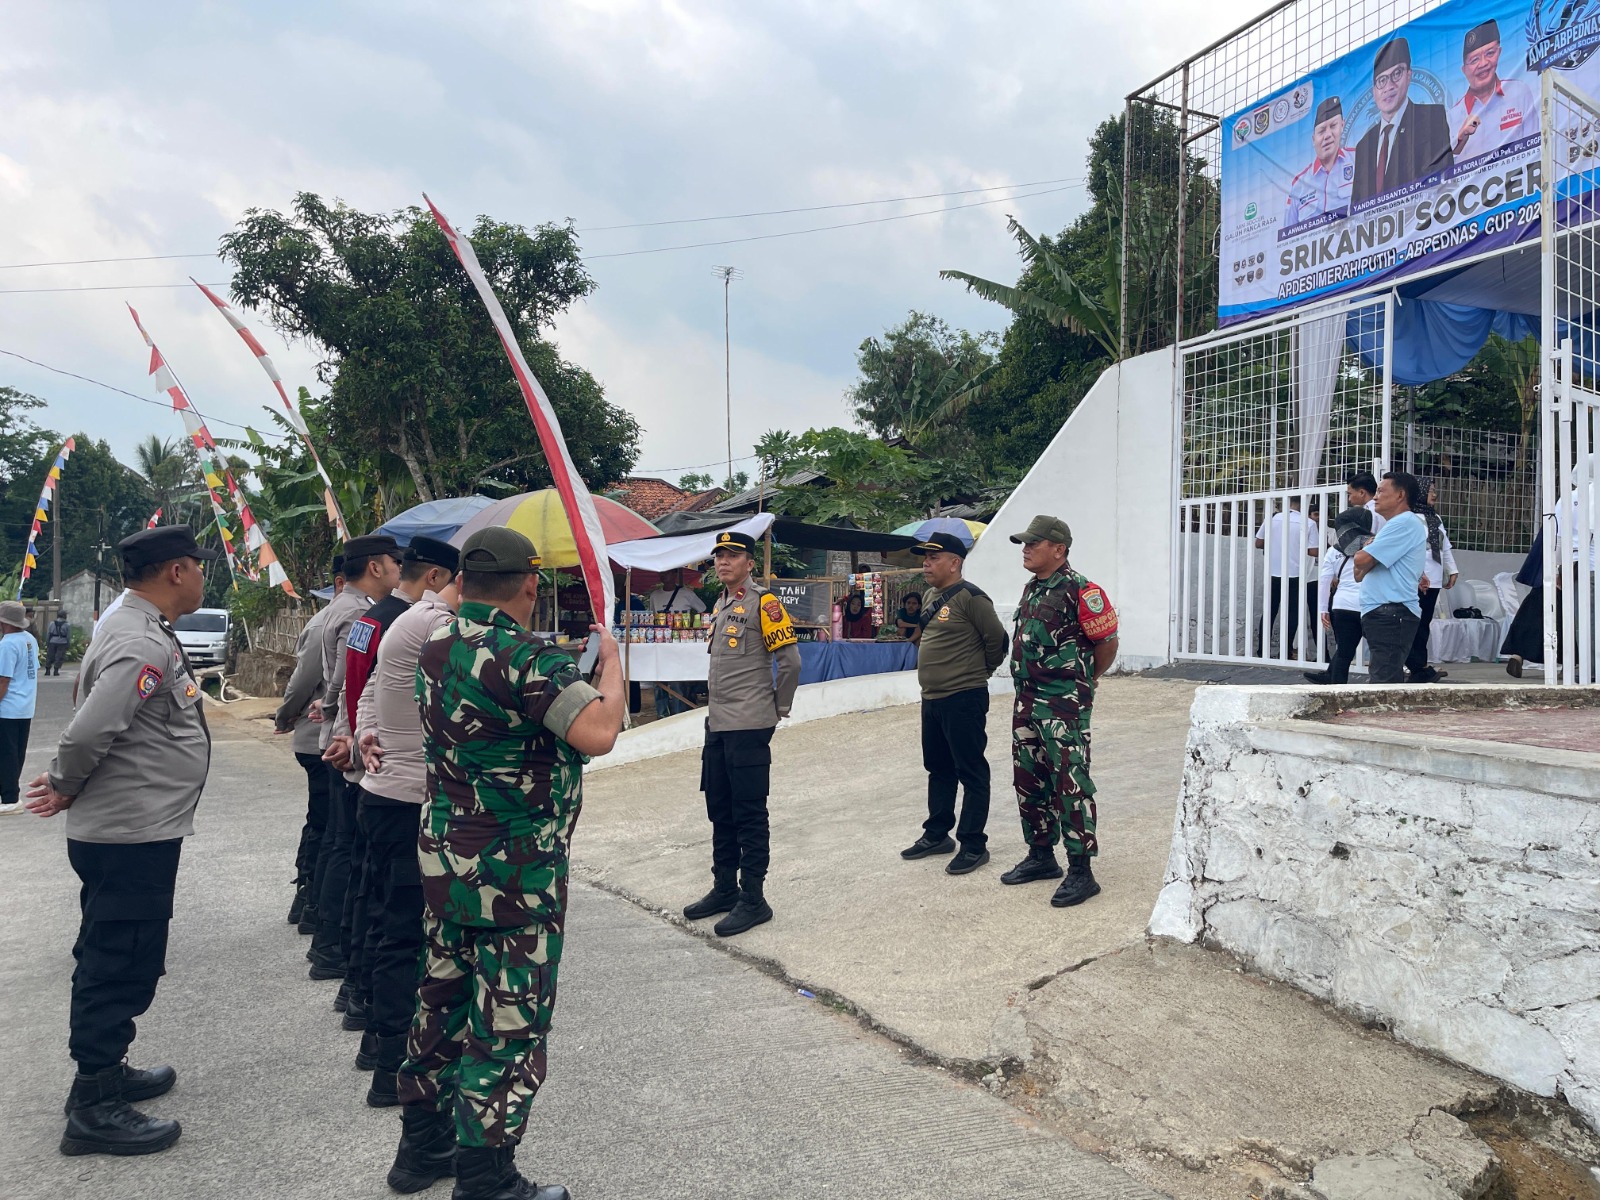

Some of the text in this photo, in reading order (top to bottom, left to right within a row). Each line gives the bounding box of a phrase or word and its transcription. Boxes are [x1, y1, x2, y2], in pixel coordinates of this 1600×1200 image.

[1501, 148, 1540, 166] ABPEDNAS
[1463, 161, 1479, 171] INDRA
[1353, 199, 1377, 212] YANDRI
[1261, 216, 1276, 227] RASA
[1280, 161, 1541, 275] SRIKANDI SOCCER
[1287, 223, 1308, 235] ANWAR
[1278, 273, 1316, 300] APDESI
[1318, 260, 1358, 287] MERAH
[1361, 247, 1397, 276] PUTIH
[1405, 222, 1478, 261] ABPEDNAS
[1485, 210, 1514, 234] CUP
[1518, 202, 1542, 226] 202
[780, 586, 806, 595] TAHU
[776, 596, 800, 605] RISPY
[727, 615, 747, 625] POLRI
